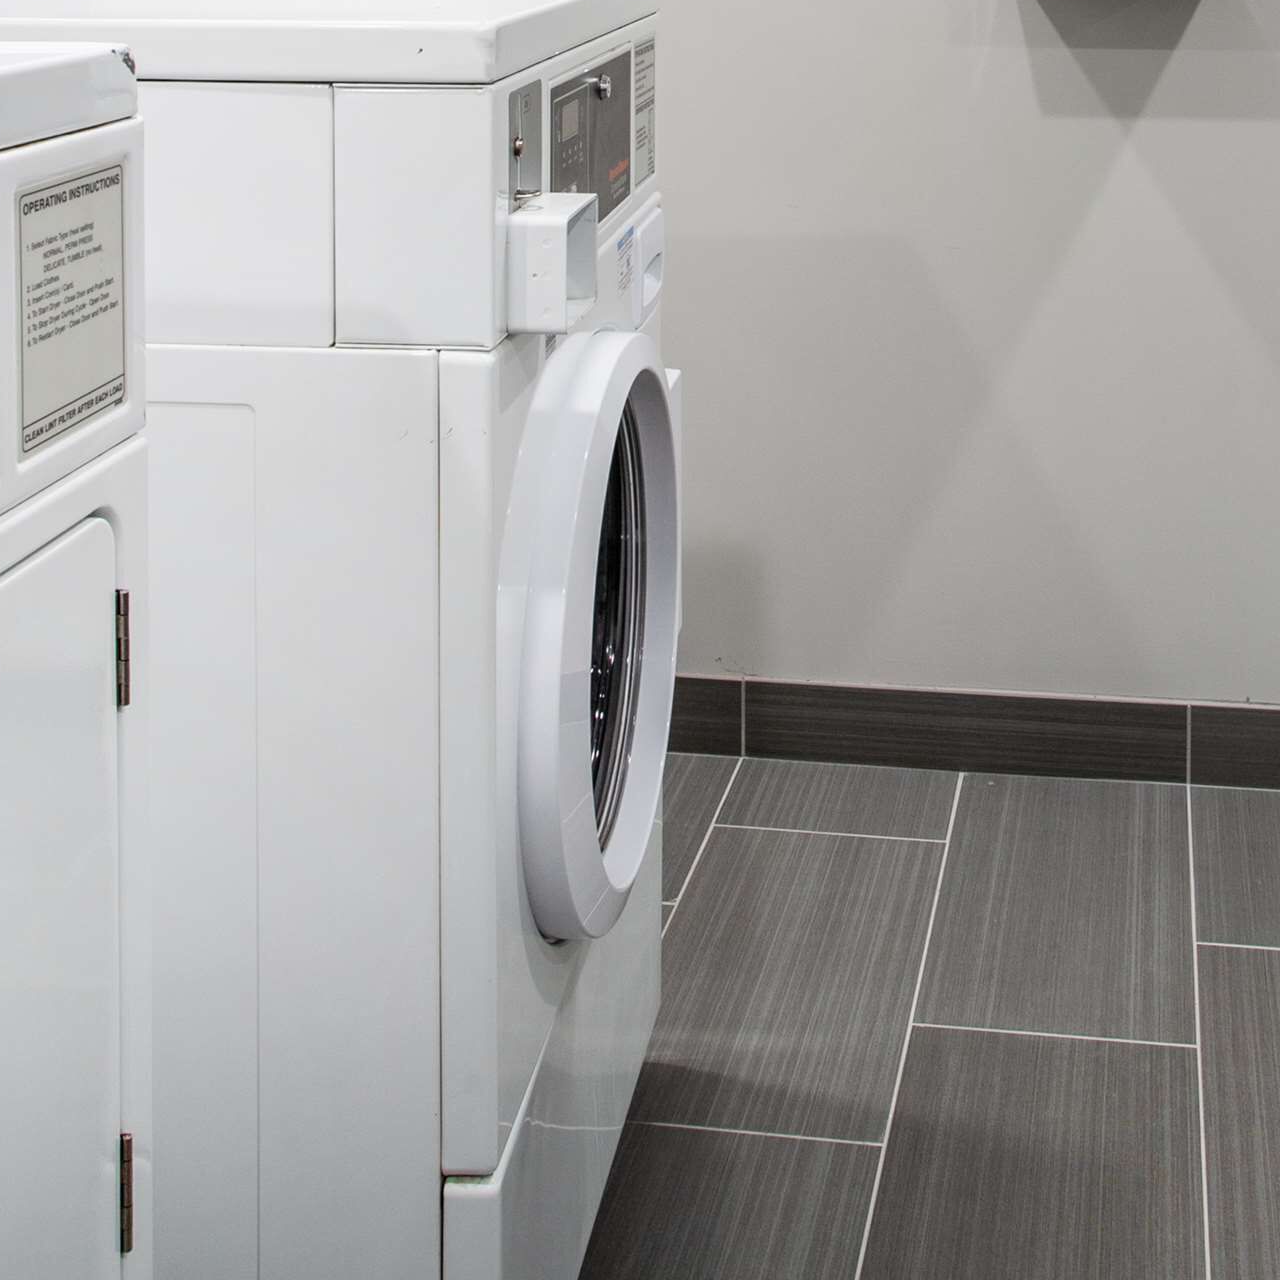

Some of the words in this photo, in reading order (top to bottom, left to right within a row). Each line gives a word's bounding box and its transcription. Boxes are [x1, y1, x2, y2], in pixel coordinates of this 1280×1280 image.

[23, 191, 67, 216] OPERATING
[69, 174, 120, 200] INSTRUCTIONS
[25, 426, 43, 444] CLEAN
[45, 419, 56, 432] LINT
[58, 408, 76, 425] FILTER
[77, 398, 93, 414] AFTER
[95, 390, 108, 404] EACH
[109, 383, 122, 396] LOAD
